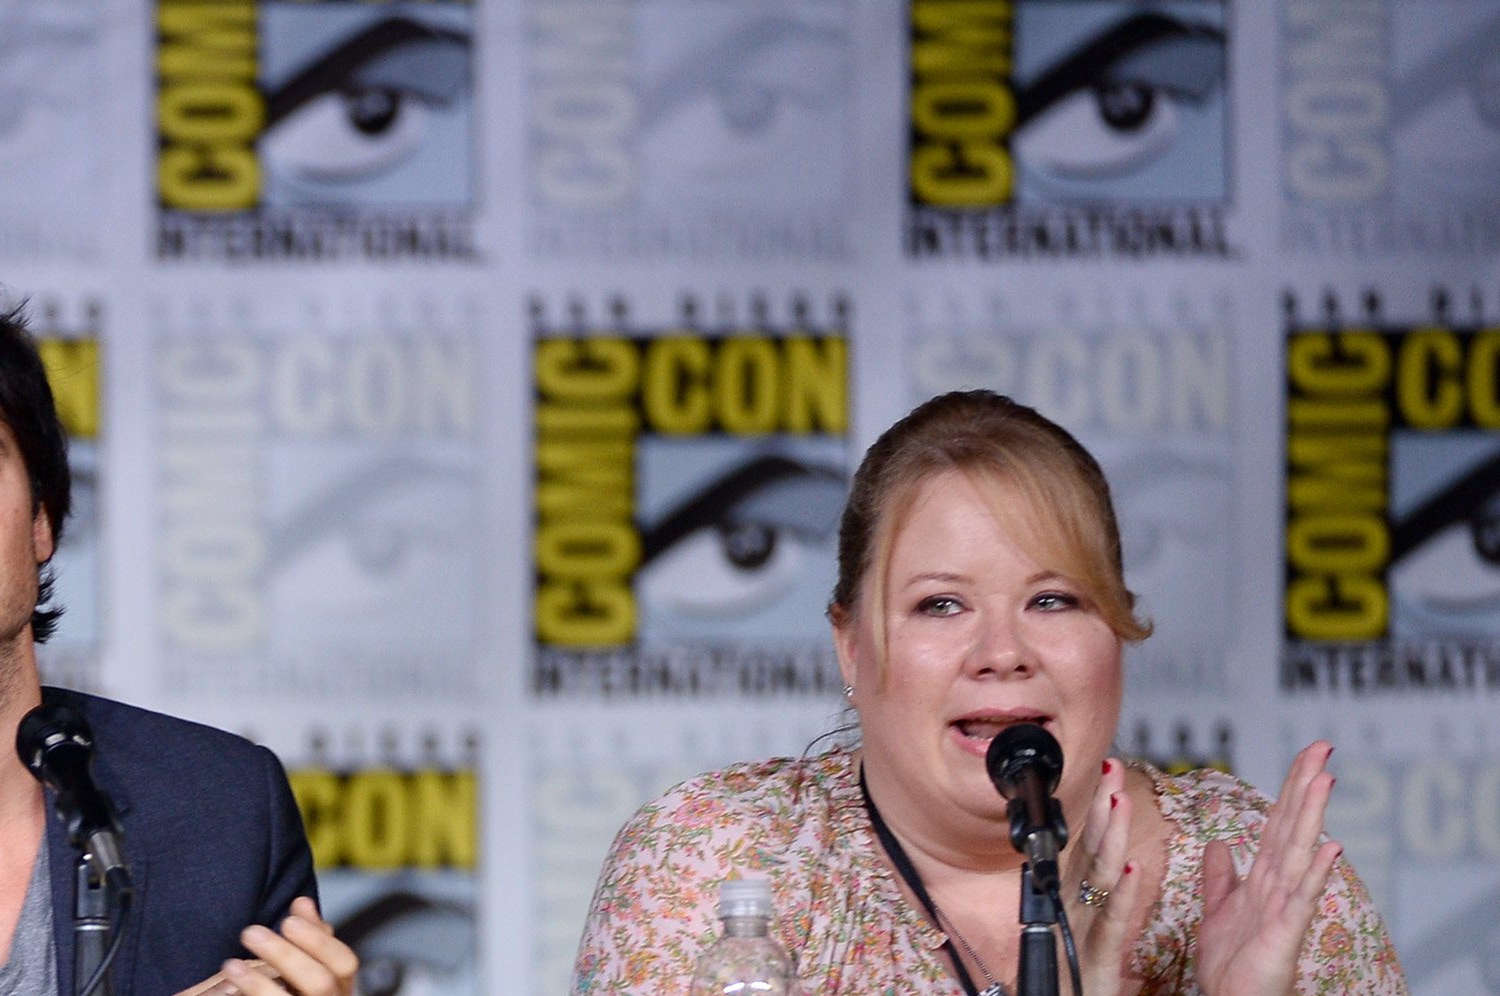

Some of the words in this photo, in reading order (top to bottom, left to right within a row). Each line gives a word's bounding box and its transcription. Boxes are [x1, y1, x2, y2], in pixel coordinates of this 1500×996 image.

[536, 338, 639, 646] COMIC
[644, 336, 847, 435] CON
[1287, 333, 1390, 640] COMIC
